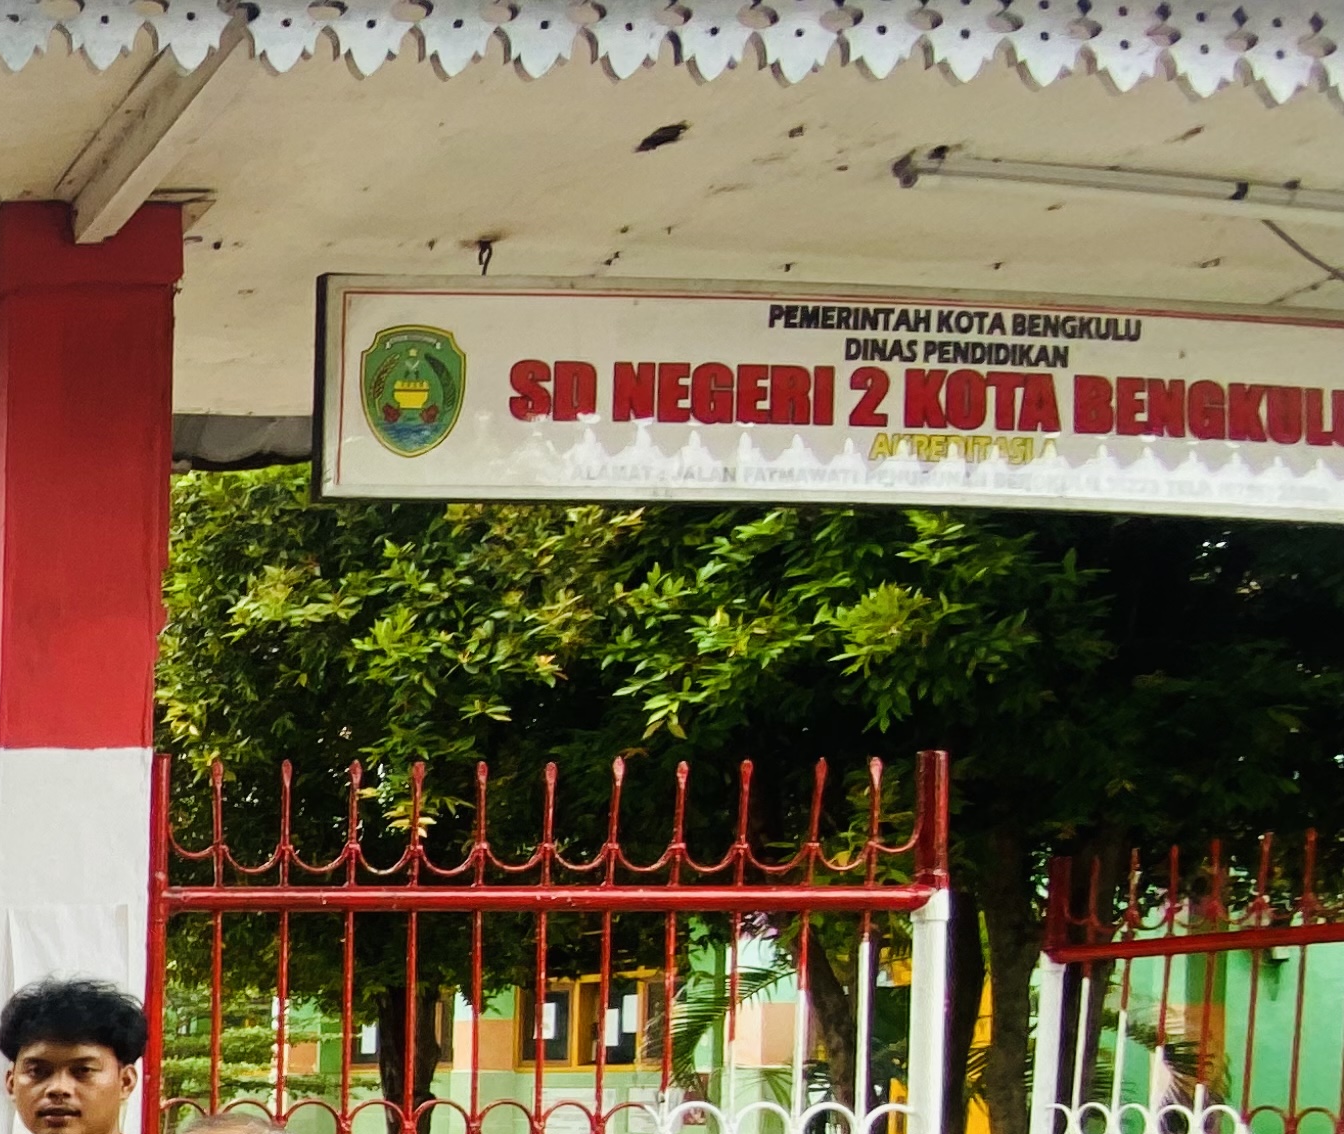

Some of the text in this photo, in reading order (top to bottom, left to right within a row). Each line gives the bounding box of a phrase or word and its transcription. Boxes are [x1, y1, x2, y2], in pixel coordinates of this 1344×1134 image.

[768, 304, 1142, 343] PEMERINTAH KOTA BENGKULU
[845, 337, 1069, 369] DINAS PENDIDIKAN
[509, 359, 598, 423] SD
[613, 361, 835, 426] NEGERI
[848, 365, 890, 428] 2
[904, 367, 1062, 434] KOTA
[868, 432, 1035, 465] AKREDITASI
[570, 464, 653, 482] ALAMAT
[671, 465, 737, 483] JALAN
[743, 466, 859, 485] FATMAWATI
